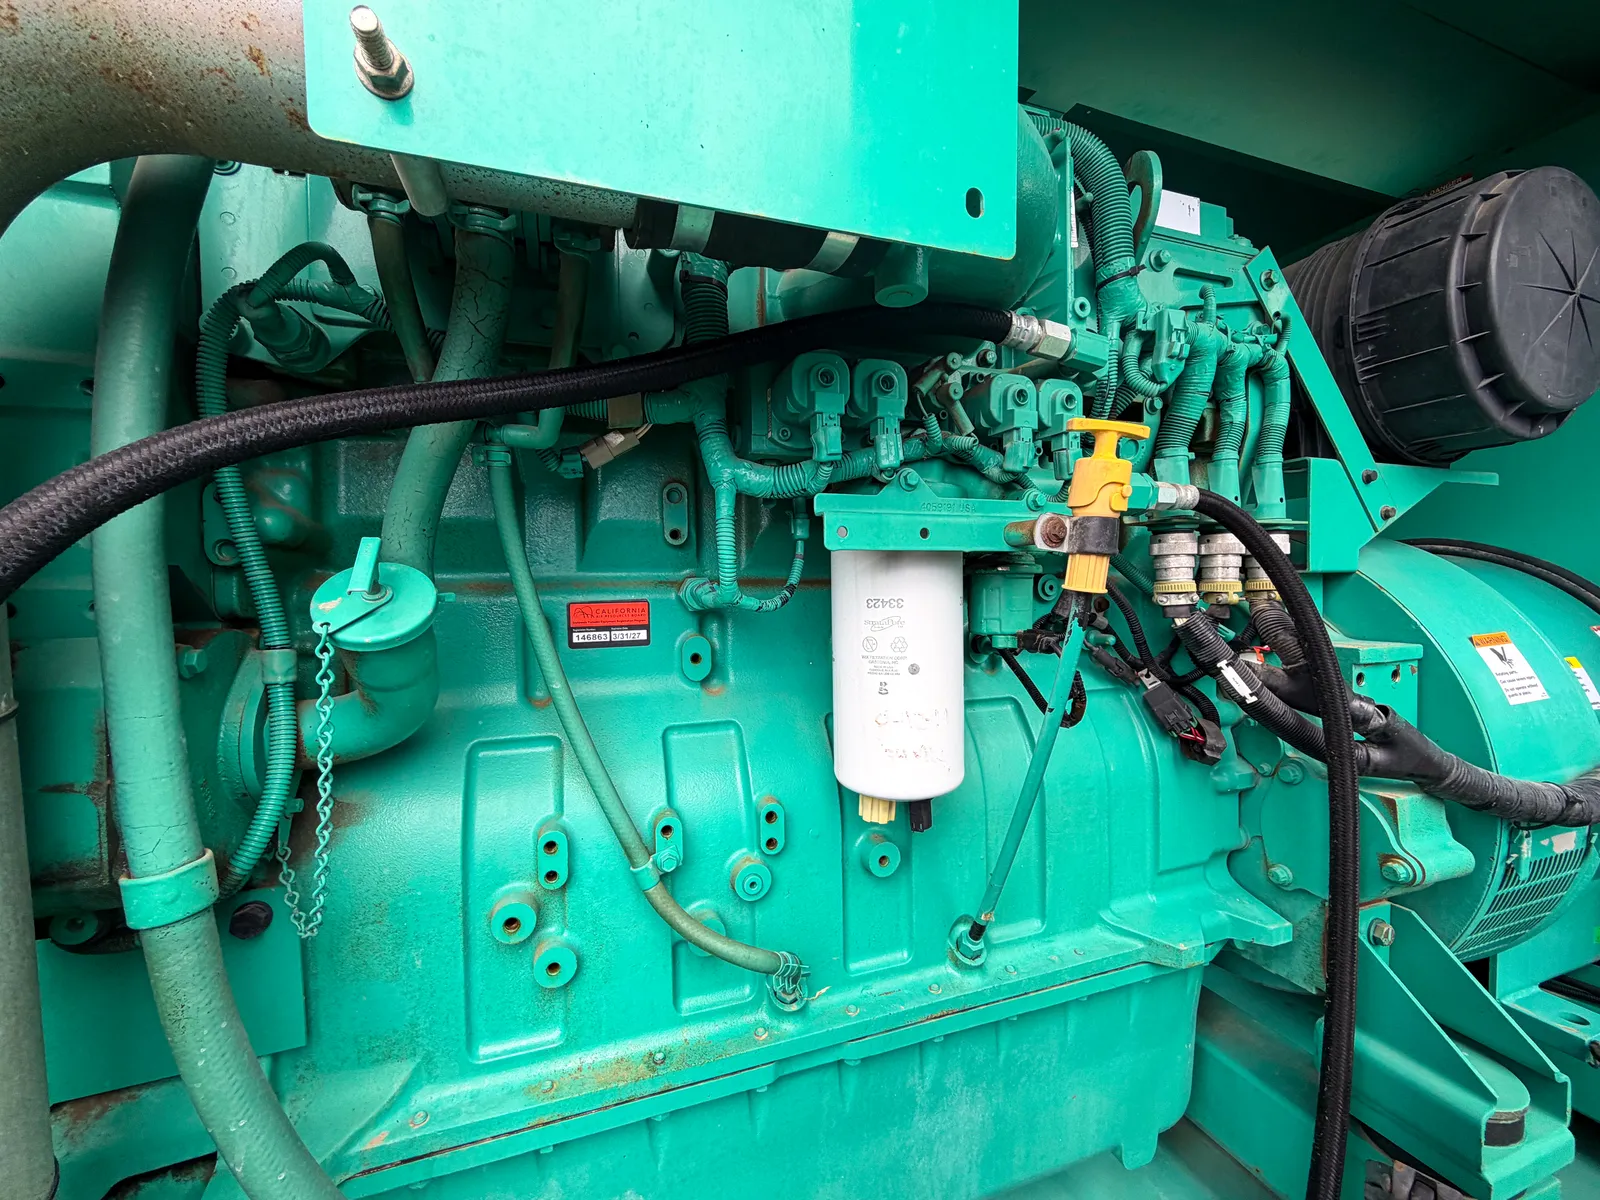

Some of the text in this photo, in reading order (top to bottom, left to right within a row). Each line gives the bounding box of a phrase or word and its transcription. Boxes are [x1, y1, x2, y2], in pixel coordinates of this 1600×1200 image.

[1430, 177, 1462, 196] DANGER
[960, 504, 976, 513] USA
[866, 598, 904, 609] 33423
[1477, 635, 1508, 645] WARNING
